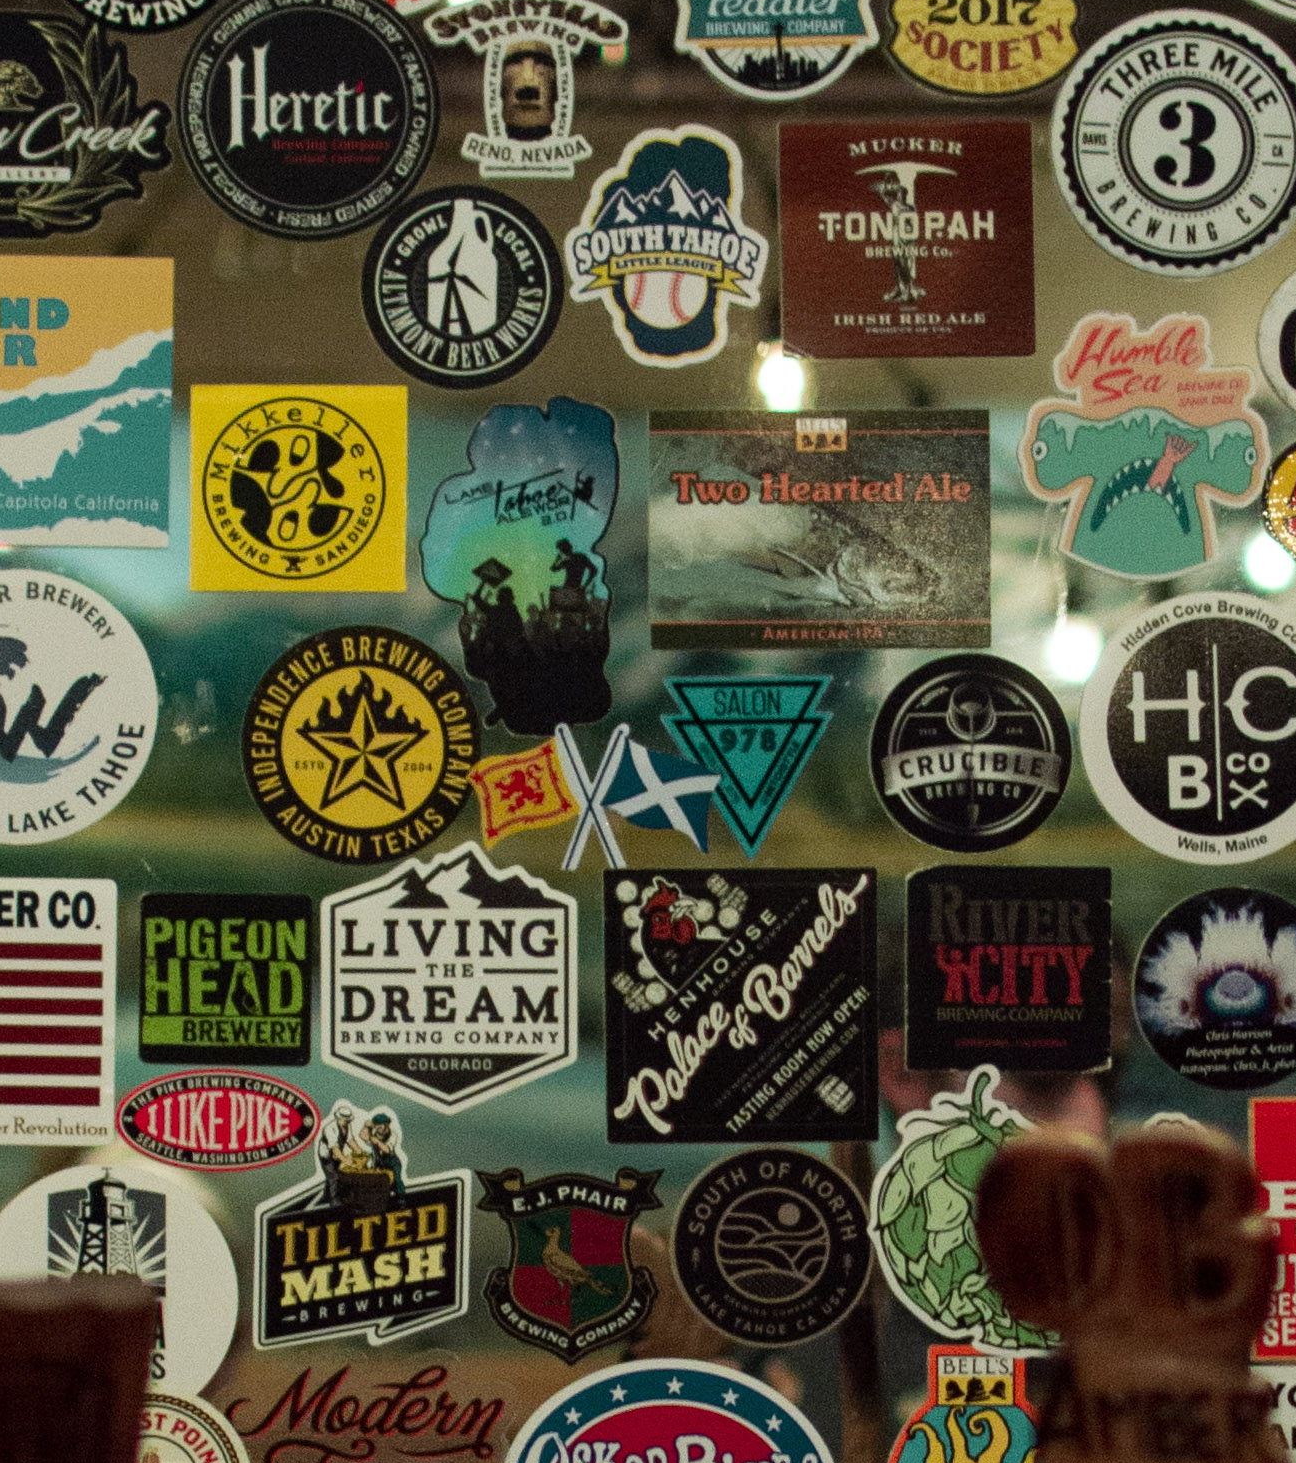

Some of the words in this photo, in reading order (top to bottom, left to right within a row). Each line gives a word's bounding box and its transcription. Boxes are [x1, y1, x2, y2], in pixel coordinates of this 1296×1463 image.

[787, 19, 845, 35] COMPANY
[907, 17, 1068, 74] SOCIETY
[226, 40, 398, 153] Heretic
[1099, 42, 1202, 100] THREE
[1211, 48, 1280, 115] MILE
[20, 102, 164, 159] Creek
[1153, 100, 1218, 187] 3
[818, 211, 995, 241] TONOPAH
[575, 226, 665, 277] SOUTH
[668, 227, 759, 279] TAHOE
[865, 245, 927, 258] BREWING
[74, 492, 160, 513] California
[673, 474, 750, 505] Two
[761, 474, 904, 503] Hearted
[907, 474, 972, 501] Ale
[713, 691, 781, 716] SALON
[897, 753, 1047, 779] CRUCIBLE
[48, 890, 102, 931] CO.
[145, 918, 305, 960] PIGEON
[341, 918, 559, 958] LIVING
[143, 958, 304, 1016] HEAD
[426, 963, 474, 978] THE
[340, 985, 559, 1024] DREAM
[614, 1002, 731, 1135] Palace
[728, 1011, 753, 1050] of
[745, 875, 870, 1029] Barrels
[181, 1019, 302, 1046] BREWERY
[227, 1093, 290, 1137] PIKE
[512, 1196, 531, 1212] E.
[556, 1187, 628, 1212] PHAIR
[276, 1202, 449, 1266] TILTED
[279, 1242, 447, 1306] MASH
[225, 1364, 506, 1437] Modern
